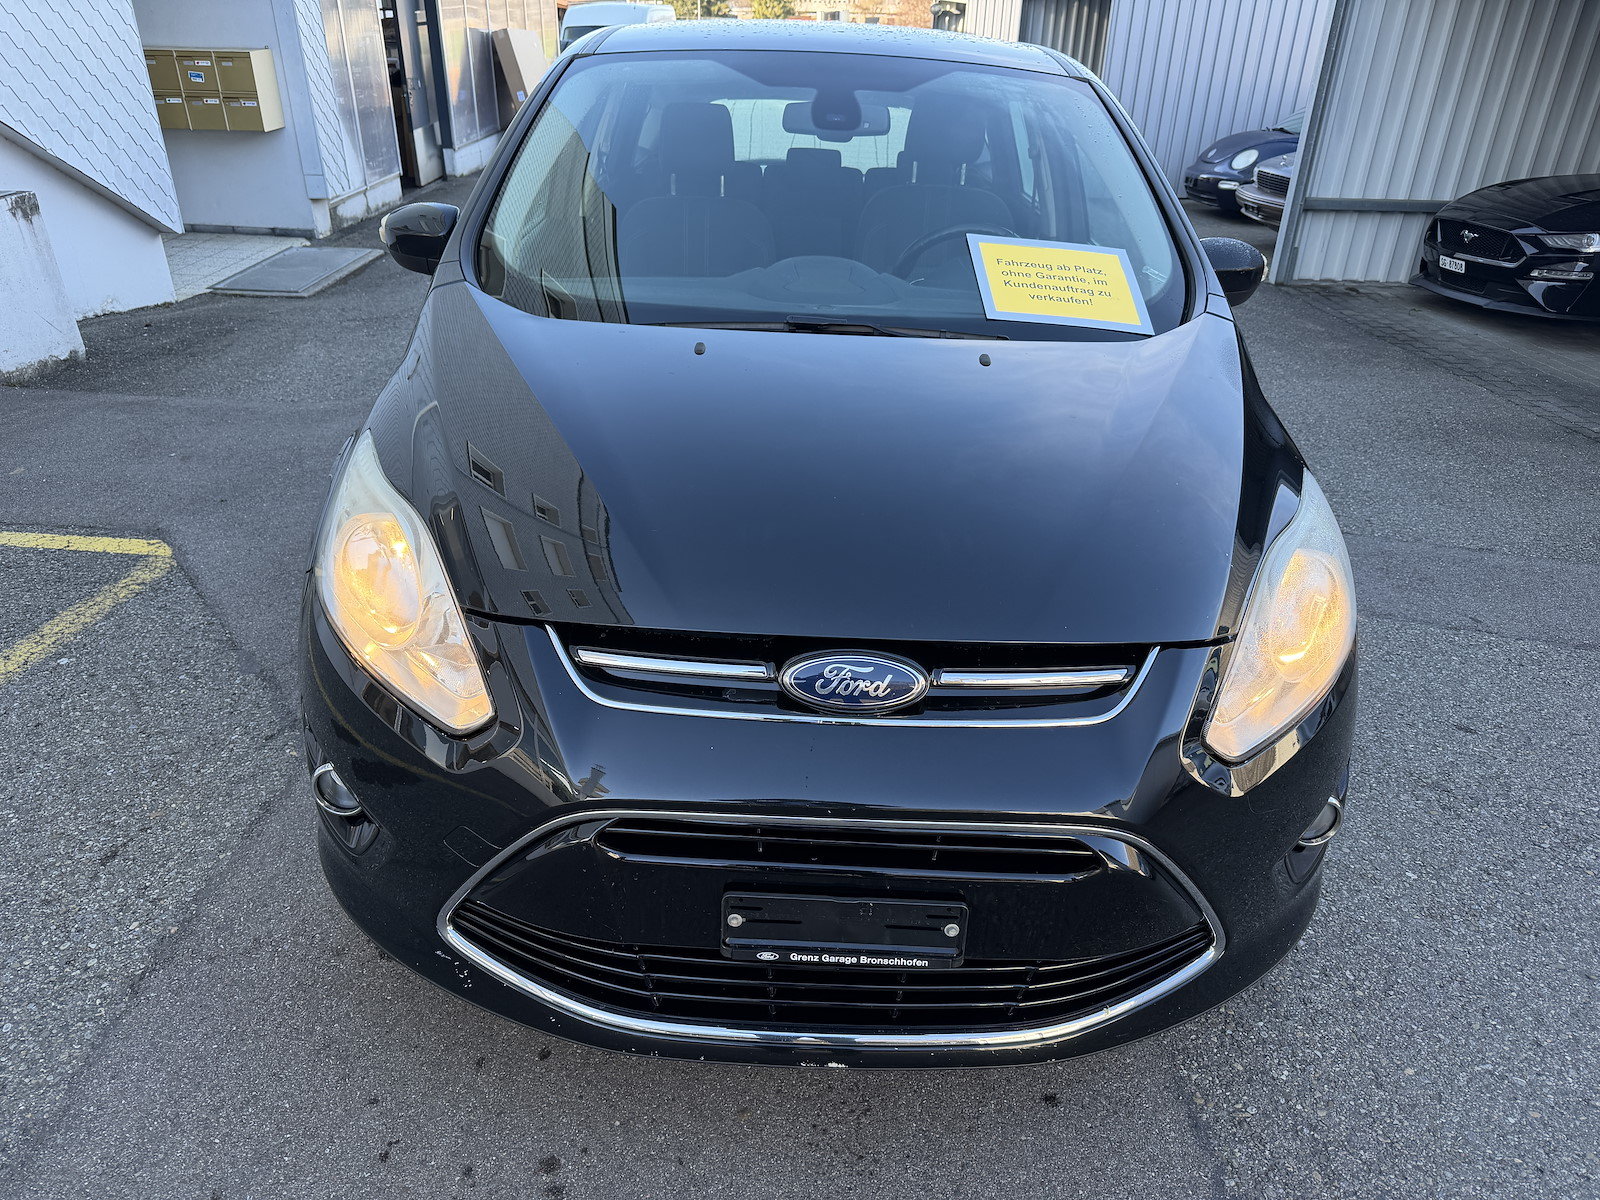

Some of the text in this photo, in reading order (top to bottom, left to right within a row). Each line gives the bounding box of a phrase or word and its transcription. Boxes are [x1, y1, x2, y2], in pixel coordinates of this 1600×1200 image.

[996, 258, 1107, 276] Fahrzeug ab Platz,
[1001, 270, 1108, 286] ohne Garantie, im
[1003, 280, 1112, 298] Kundenauftrag zu
[1029, 293, 1094, 306] verkaufen!
[815, 664, 893, 697] Ford
[790, 952, 929, 968] Grenz Garage Bronschhofen
